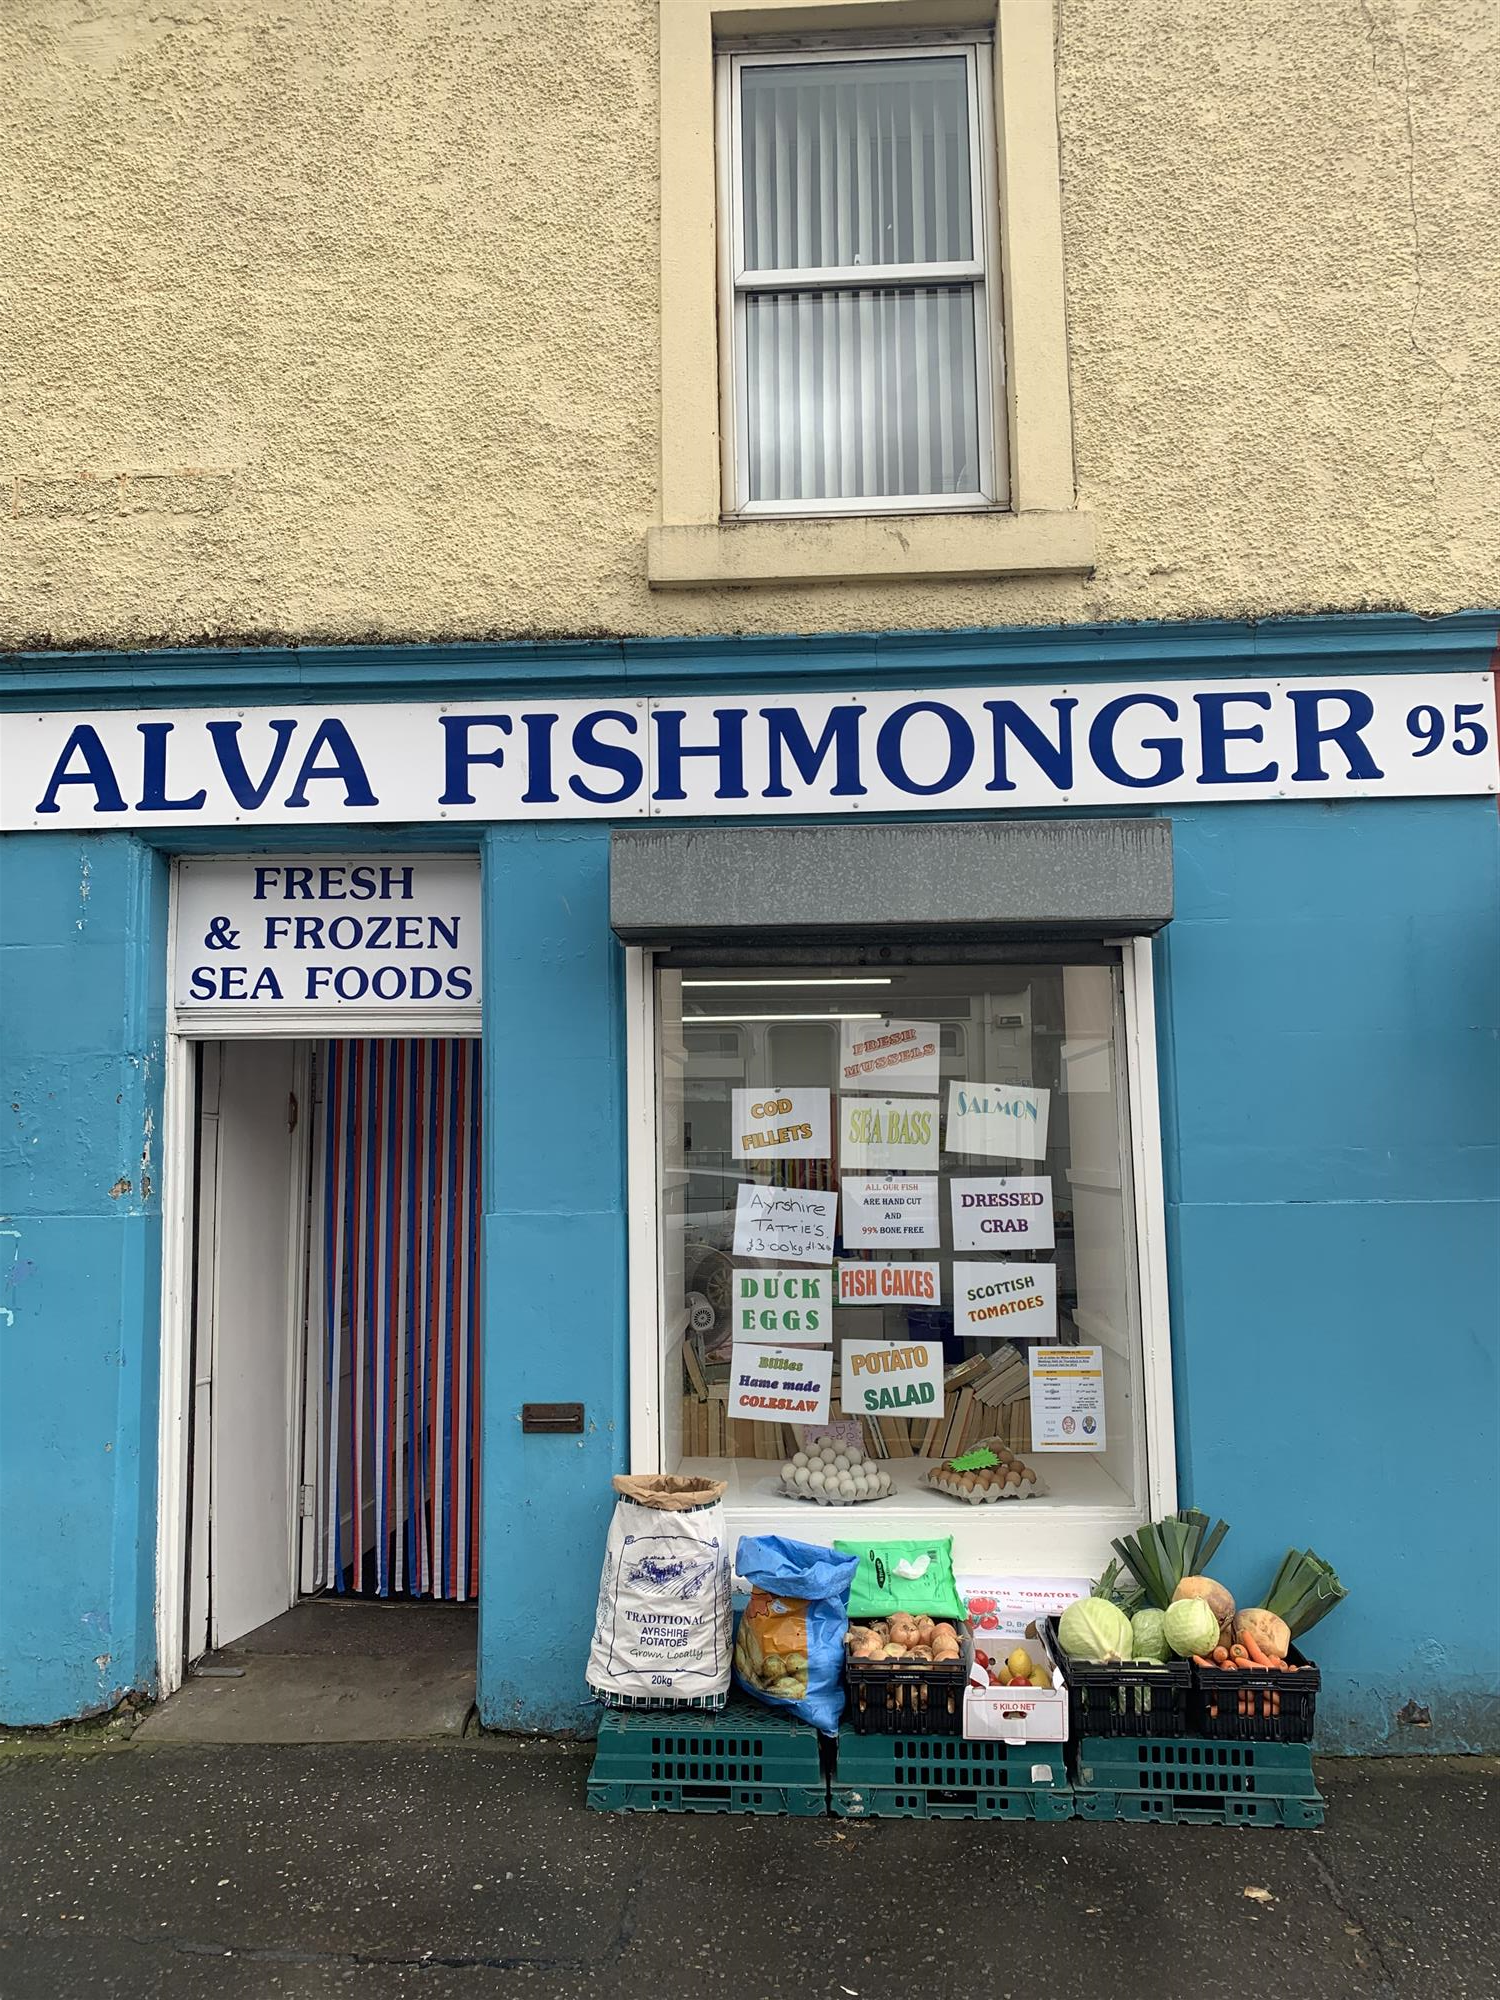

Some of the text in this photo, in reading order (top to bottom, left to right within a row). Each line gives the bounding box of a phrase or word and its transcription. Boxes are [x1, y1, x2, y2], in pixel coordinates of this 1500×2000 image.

[36, 689, 1489, 813] ALVA FISHMONGER 95
[253, 867, 414, 900] FRESH
[204, 916, 461, 951] & FROZEN
[189, 966, 473, 1001] SEA FOODS
[852, 1028, 917, 1056] FRESH
[844, 1043, 936, 1078] MUSSELS
[751, 1098, 793, 1119] COD
[956, 1091, 1038, 1123] SALMON
[742, 1123, 813, 1151] FILLETS
[849, 1108, 932, 1146] SEA BASS
[865, 1183, 918, 1191] ALL OUR FISH
[751, 1194, 826, 1216] Ayrshire
[961, 1192, 1044, 1208] DRESSED
[884, 1212, 901, 1220] AND
[980, 1218, 1029, 1233] CRAB
[862, 1226, 924, 1235] 99% BONE FREE
[740, 1277, 821, 1299] DUCK
[841, 1268, 935, 1299] FISH CAKES
[967, 1276, 1035, 1301] SCOTTISH
[742, 1309, 820, 1331] EGGS
[968, 1295, 1044, 1323] TOMATOES
[851, 1345, 929, 1376] POTATO
[782, 1380, 821, 1393] made
[864, 1381, 935, 1411] SALAD
[739, 1395, 819, 1412] COLESLAW
[625, 1610, 705, 1625] TRADITIONAL
[640, 1637, 688, 1648] POTATOES
[641, 1627, 689, 1638] AYRSHIRE
[630, 1648, 704, 1660] Grown Locally
[651, 1675, 673, 1687] 20kg
